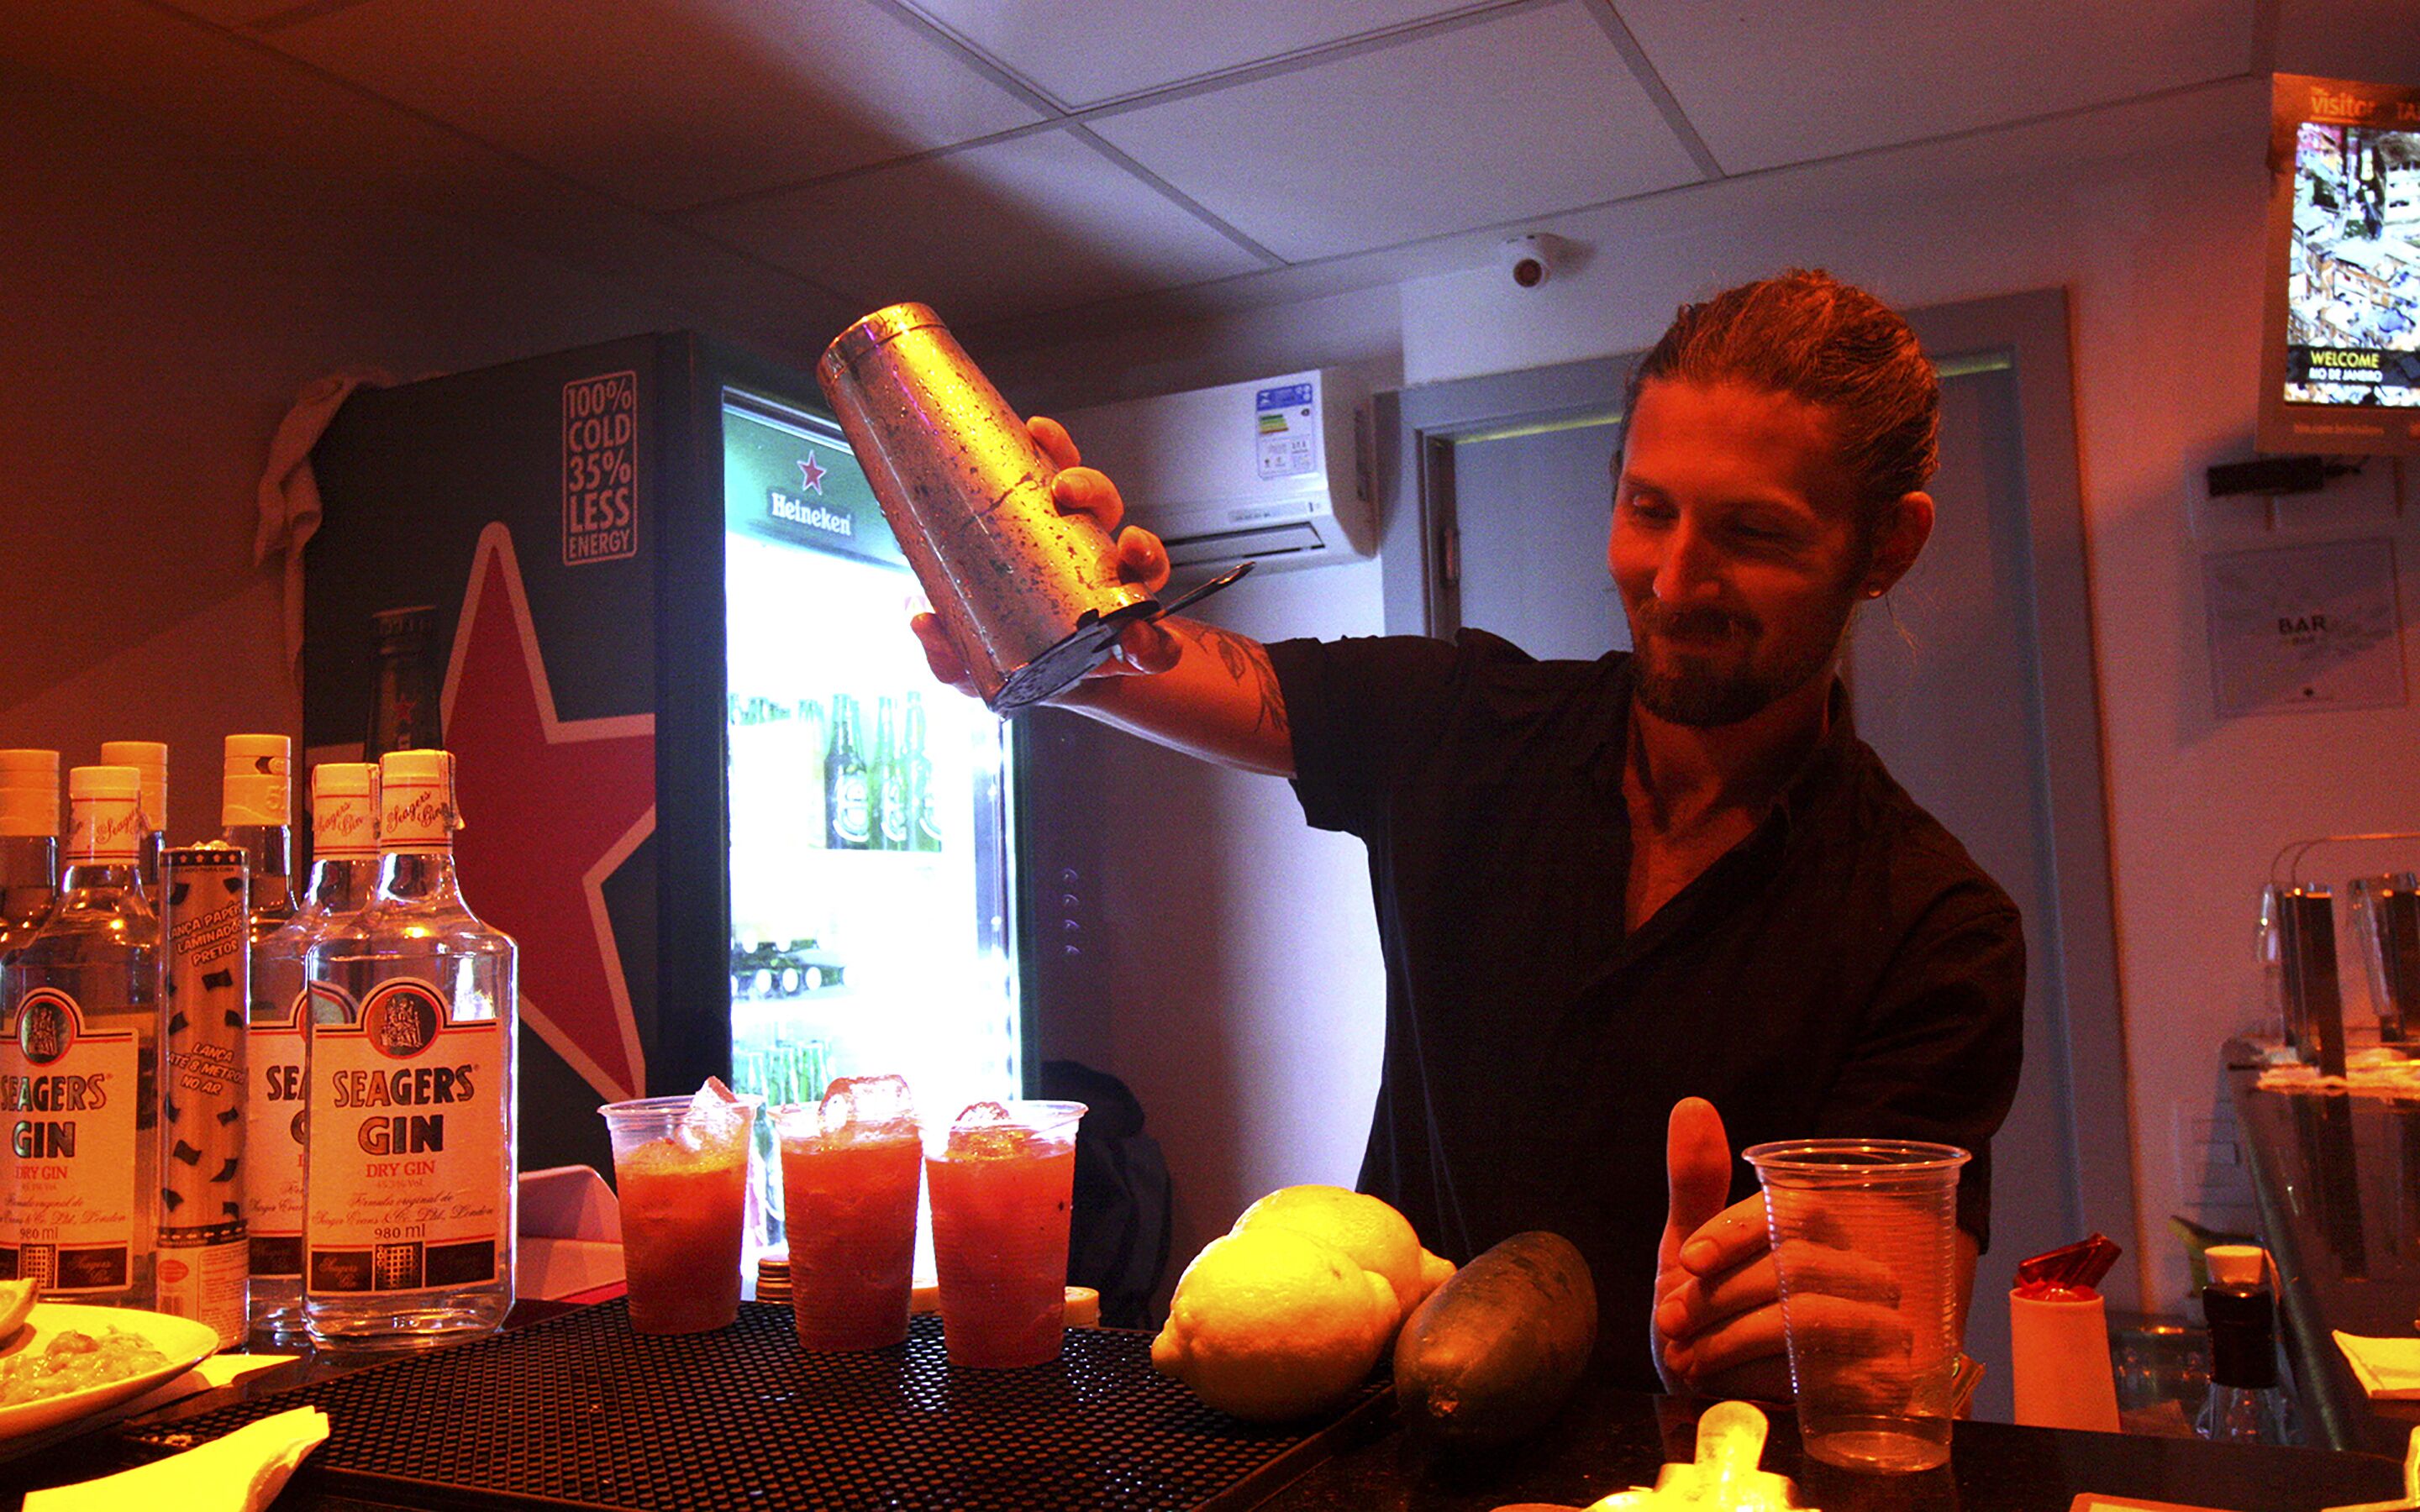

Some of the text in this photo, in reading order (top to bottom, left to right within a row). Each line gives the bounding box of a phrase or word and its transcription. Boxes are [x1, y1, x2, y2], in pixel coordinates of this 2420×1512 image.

[2311, 351, 2380, 368] WELCOME
[568, 377, 632, 418] 100%
[569, 413, 631, 452] COLD
[569, 448, 632, 492] 35%
[569, 486, 629, 533] LESS
[771, 492, 852, 536] Heineken
[569, 529, 630, 559] ENERGY
[2278, 615, 2327, 635] BAR
[171, 918, 202, 939] ANÇA
[192, 940, 238, 965] PRETOS
[169, 1052, 191, 1068] ATÉ
[188, 1059, 201, 1072] 8
[192, 1042, 234, 1063] LANÇA
[181, 1074, 223, 1095] NO AR
[333, 1064, 475, 1107] SEAGERS
[13, 1121, 76, 1158] GIN
[358, 1115, 444, 1156] GIN
[15, 1166, 68, 1179] DRY GIN
[366, 1161, 434, 1178] DRY GIN
[20, 1226, 58, 1240] 980 ml
[374, 1223, 425, 1239] 980 ml
